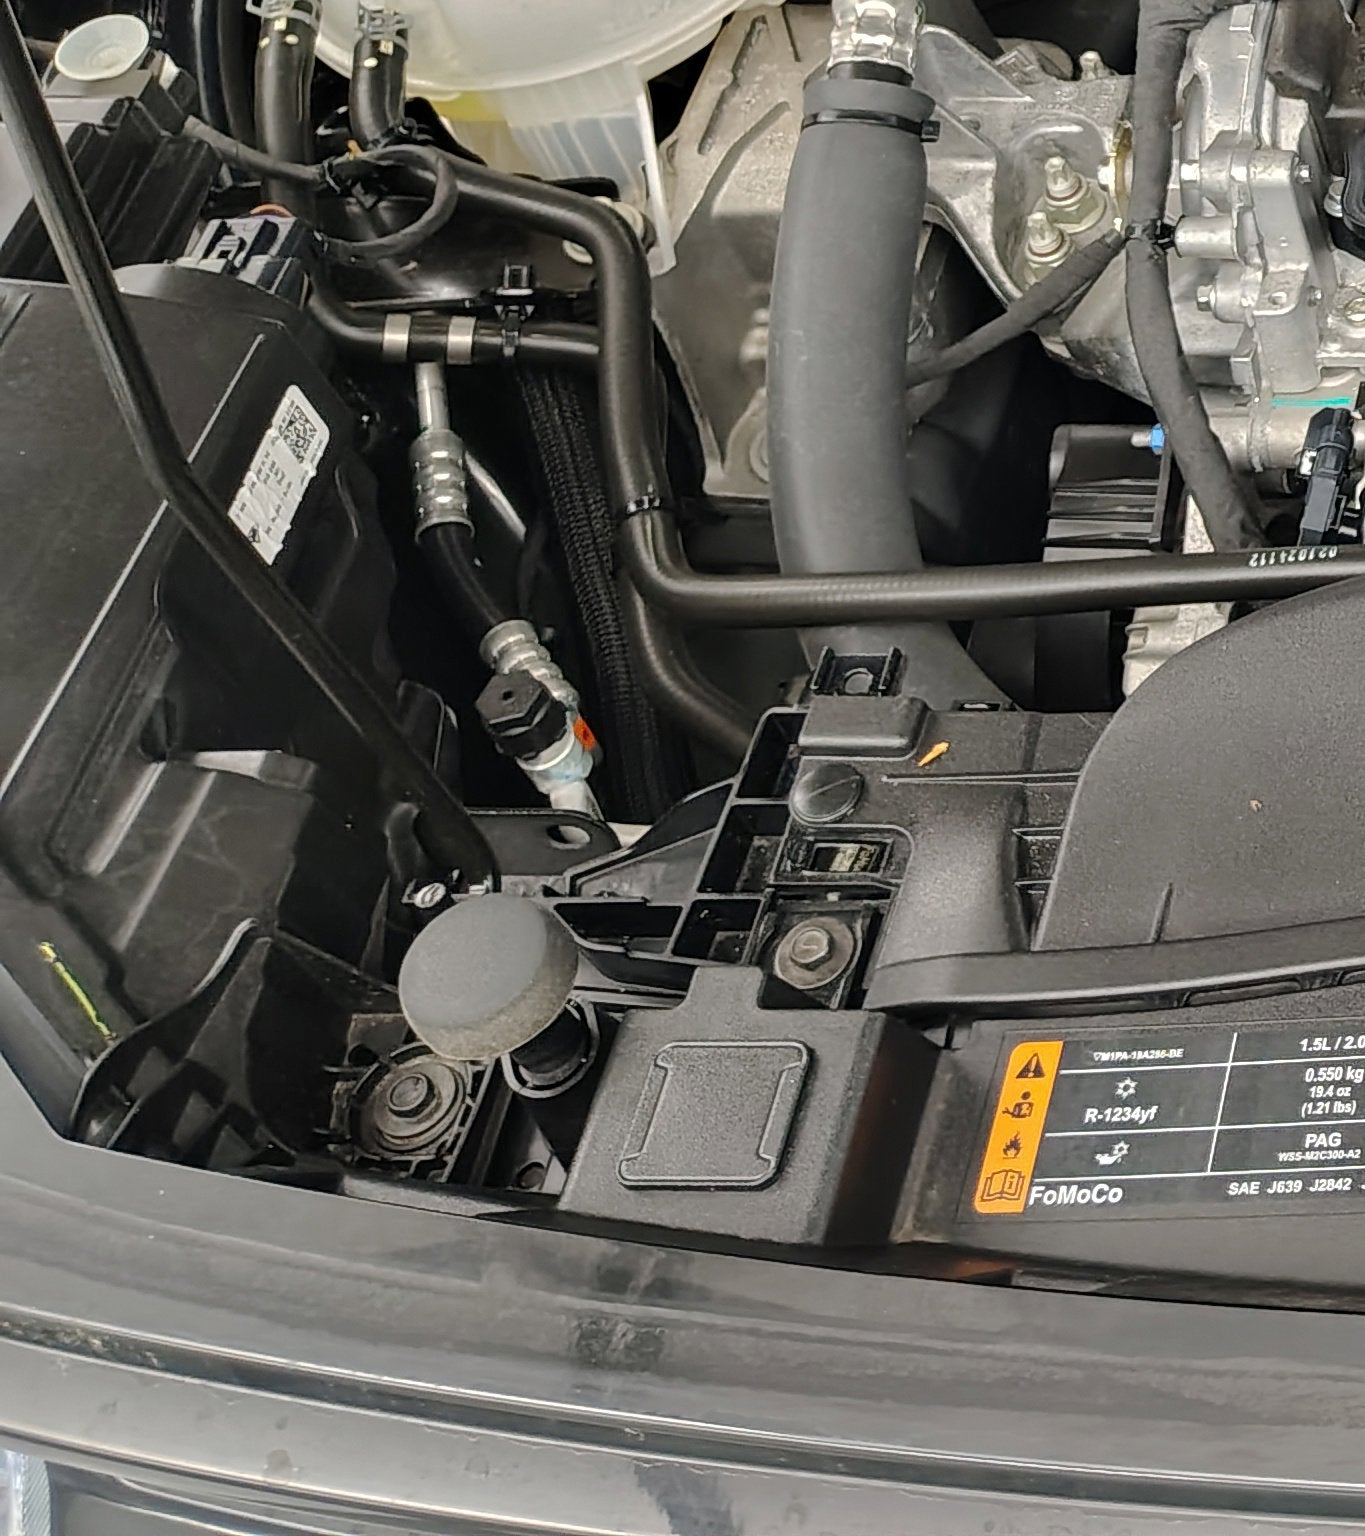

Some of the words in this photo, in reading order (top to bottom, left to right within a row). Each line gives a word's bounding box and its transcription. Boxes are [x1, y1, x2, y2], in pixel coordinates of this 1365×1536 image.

[1299, 1037, 1331, 1052] 1.5L
[1304, 1066, 1343, 1083] 0.550
[1345, 1066, 1365, 1083] kg
[1308, 1085, 1335, 1098] 19.4
[1336, 1086, 1352, 1097] oz
[1083, 1105, 1159, 1124] R-1234yf
[1301, 1101, 1330, 1118] (1.21
[1332, 1100, 1357, 1116] lbs)
[1304, 1132, 1342, 1149] PAG
[1028, 1183, 1124, 1206] FoMoCo
[1227, 1181, 1261, 1196] SAE
[1266, 1180, 1303, 1194] J639
[1308, 1177, 1352, 1192] J2842
